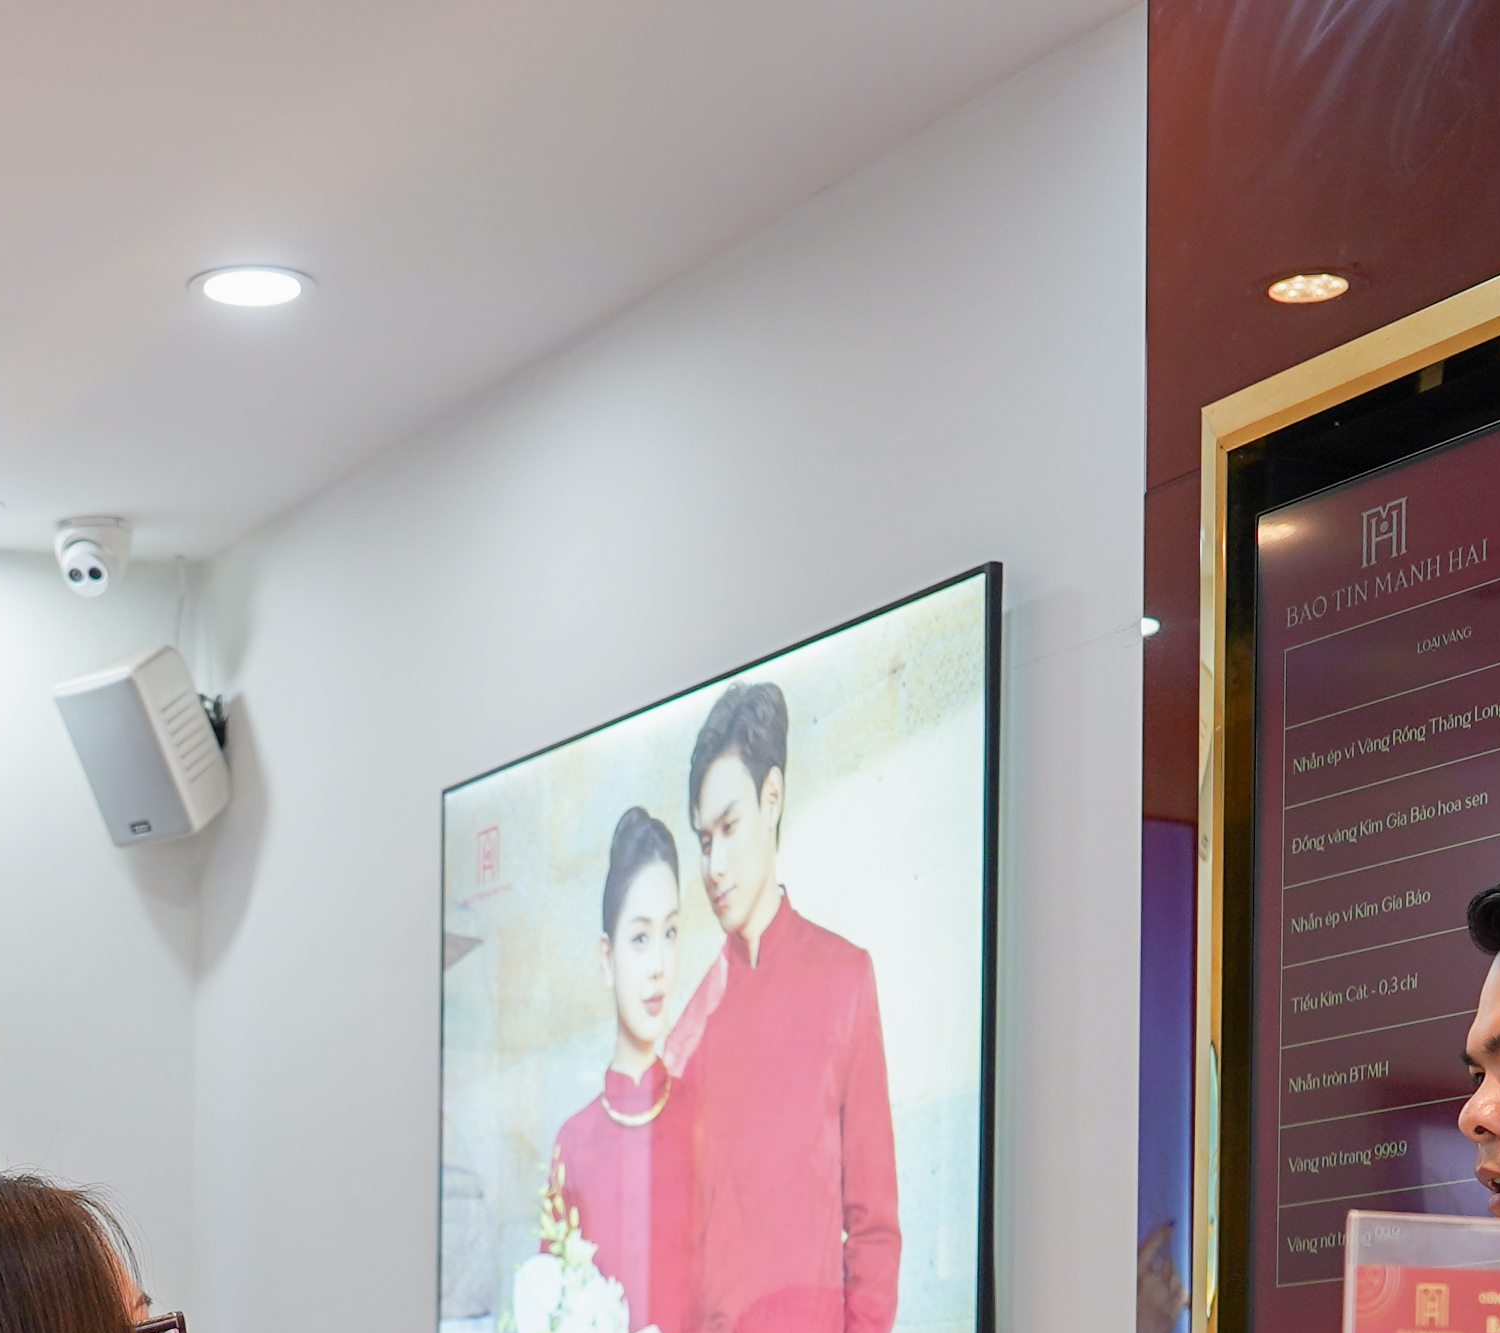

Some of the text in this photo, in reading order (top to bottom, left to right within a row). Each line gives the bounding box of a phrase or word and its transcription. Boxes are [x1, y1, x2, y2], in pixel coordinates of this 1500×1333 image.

[1332, 579, 1370, 613] TIN
[1440, 625, 1473, 648] VÀNG
[1326, 747, 1342, 769] ép
[1357, 732, 1391, 754] Vàng
[1392, 722, 1427, 747] Rồng
[1428, 708, 1473, 735] Thăng
[1326, 826, 1358, 846] vàng
[1359, 816, 1384, 837] Kim
[1385, 809, 1408, 830] Gia
[1409, 802, 1436, 824] Bảo
[1437, 798, 1463, 817] hoa
[1465, 790, 1489, 810] sen
[1324, 907, 1341, 928] ép
[1354, 898, 1379, 920] Kim
[1380, 893, 1403, 913] Gia
[1404, 887, 1432, 909] Bảo
[1319, 989, 1344, 1009] Kim
[1345, 983, 1370, 1003] Cát
[1378, 977, 1400, 1000] 0,3
[1321, 1068, 1348, 1088] tròn
[1349, 1059, 1390, 1084] BTMH
[1288, 1155, 1320, 1176] Vàng
[1338, 1147, 1373, 1167] trang
[1373, 1139, 1409, 1161] 999.9
[1287, 1234, 1319, 1254] Vàng
